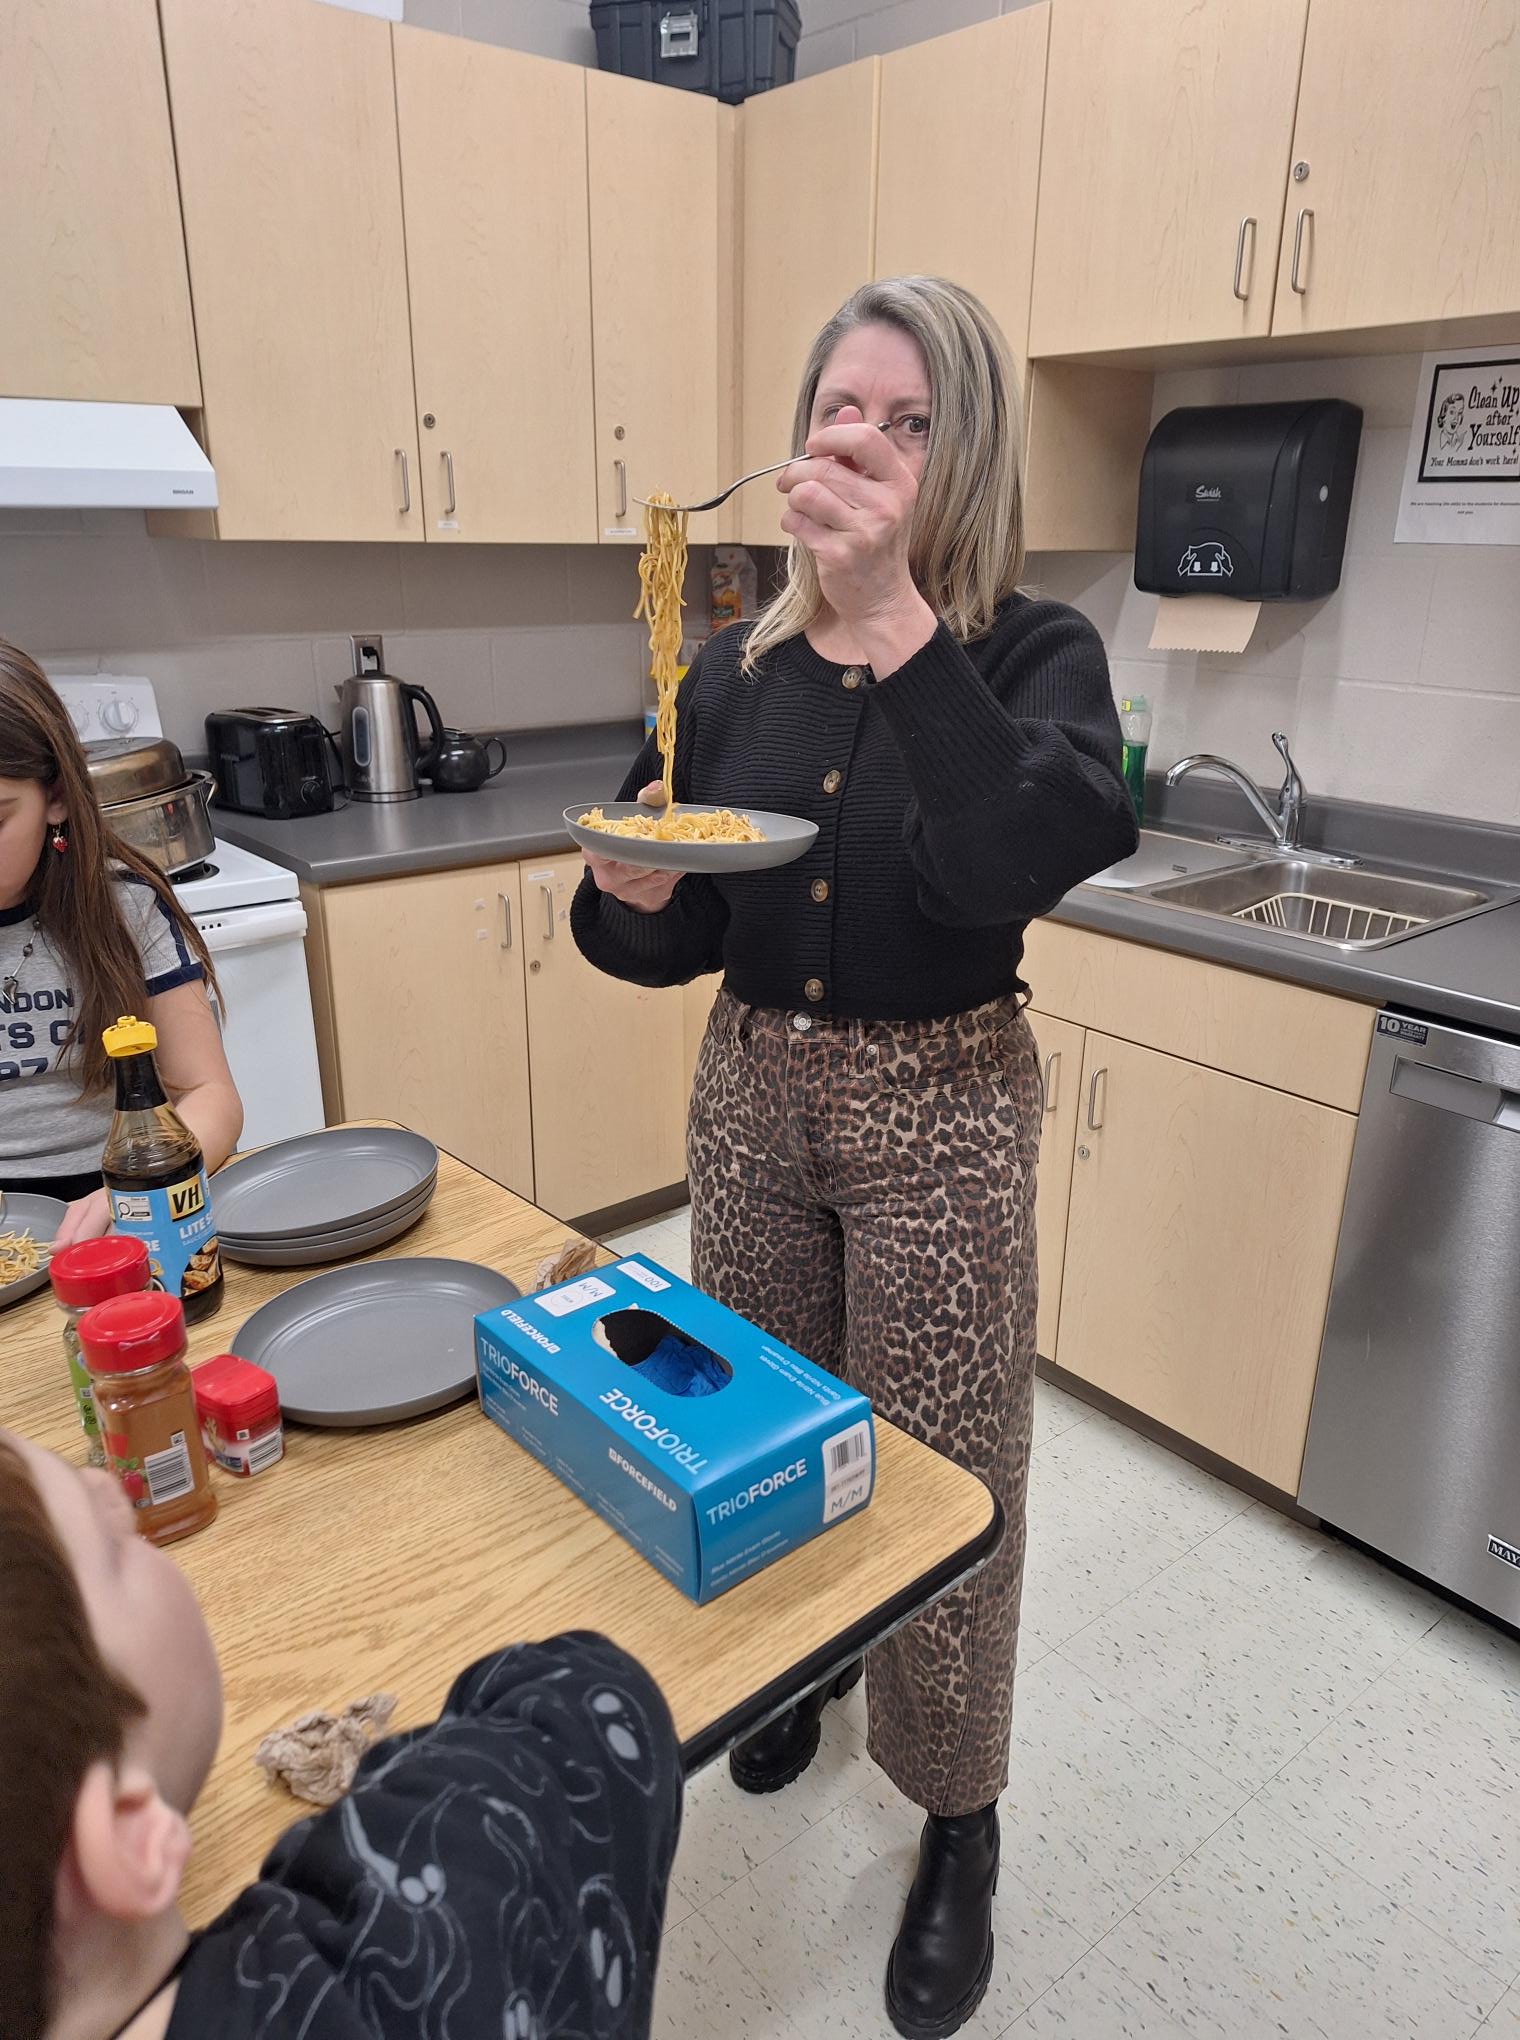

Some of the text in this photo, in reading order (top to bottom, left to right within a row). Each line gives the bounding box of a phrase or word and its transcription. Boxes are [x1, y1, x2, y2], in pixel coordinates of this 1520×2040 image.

[1468, 385, 1498, 409] Clean
[1485, 410, 1513, 426] after
[1467, 424, 1520, 450] Yourself
[1486, 456, 1501, 465] work
[1380, 1016, 1401, 1033] 10
[1401, 1021, 1427, 1033] YEAR
[172, 1184, 199, 1214] VH
[179, 1217, 206, 1240] LITE
[500, 1309, 555, 1350] FORCEFIELD
[480, 1336, 559, 1416] TRIOFORCE
[599, 1388, 708, 1475] TRIOFORCE
[616, 1453, 677, 1512] FORCEFIELD
[706, 1458, 808, 1525] TRIOFORCE
[831, 1485, 863, 1513] M/M
